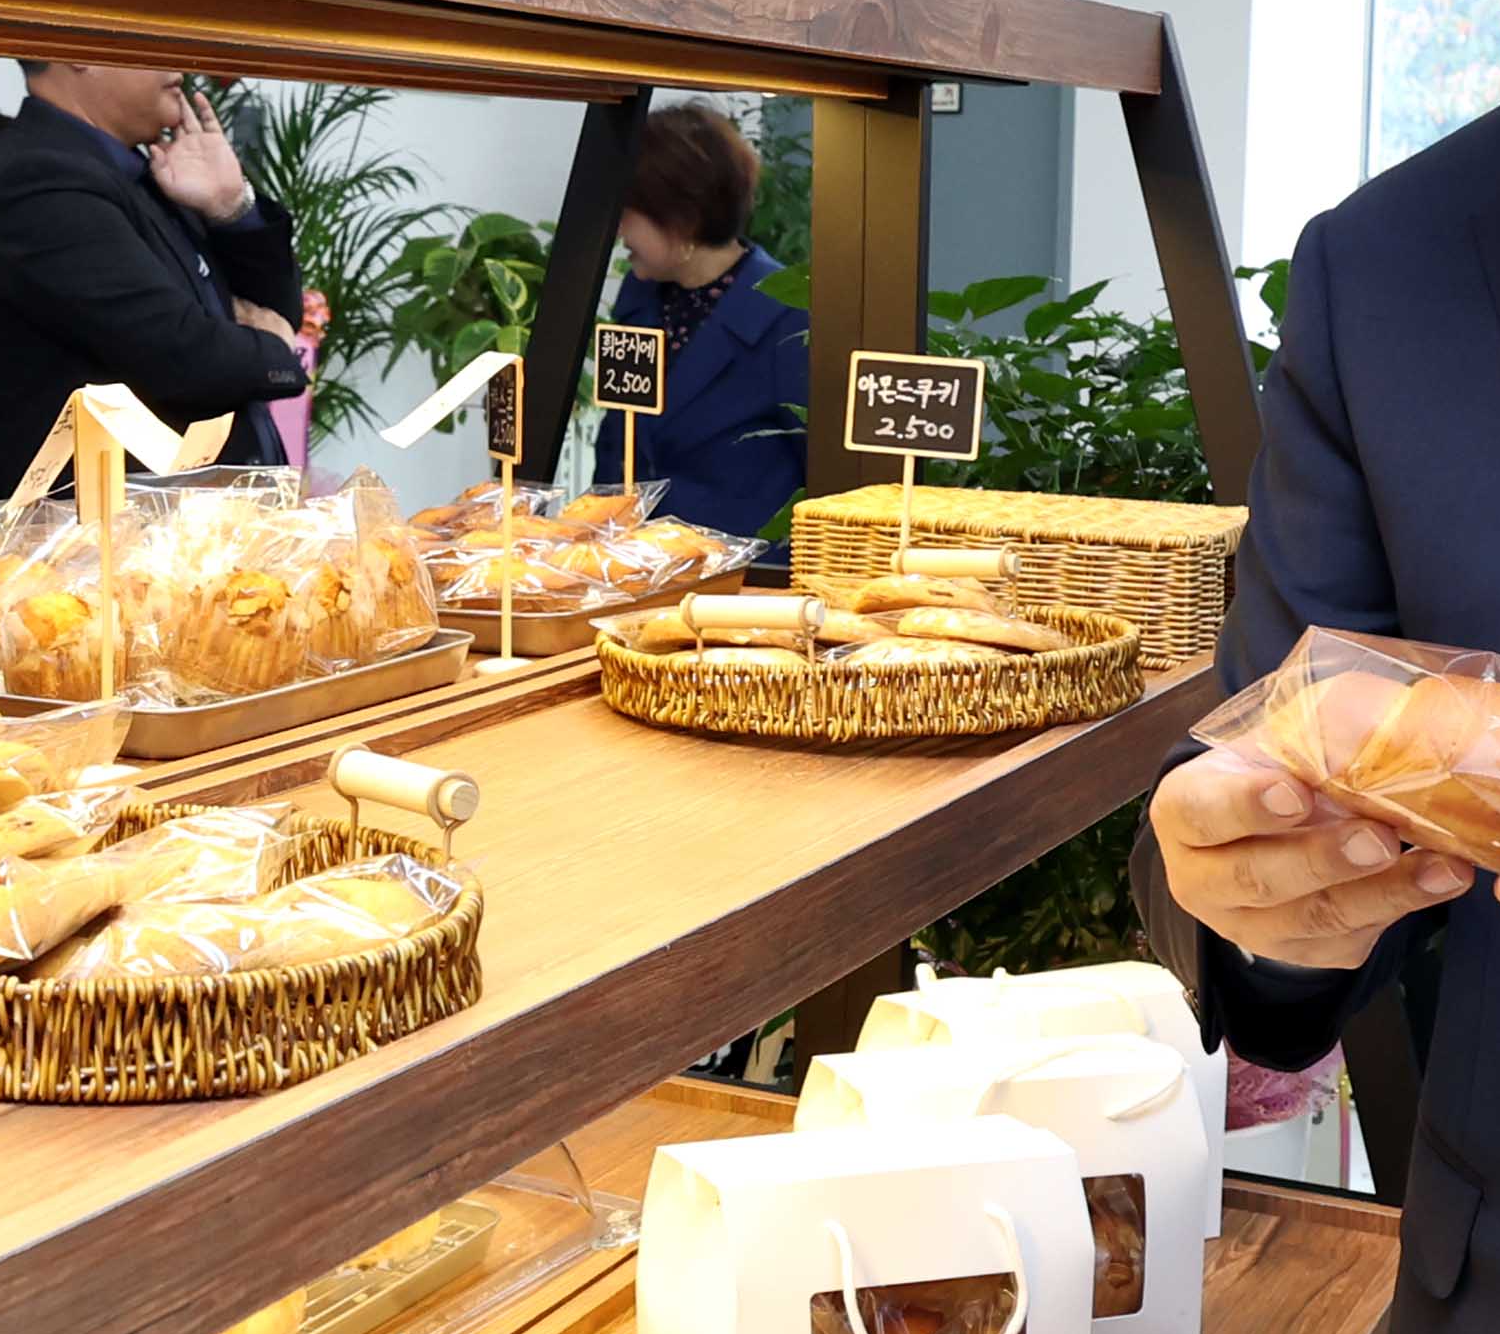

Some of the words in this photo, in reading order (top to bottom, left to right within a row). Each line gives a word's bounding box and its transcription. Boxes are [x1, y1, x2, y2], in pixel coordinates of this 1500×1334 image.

[601, 331, 656, 364] 휘낭시에
[603, 368, 652, 394] 2,500
[857, 373, 960, 409] 아몬드쿠키
